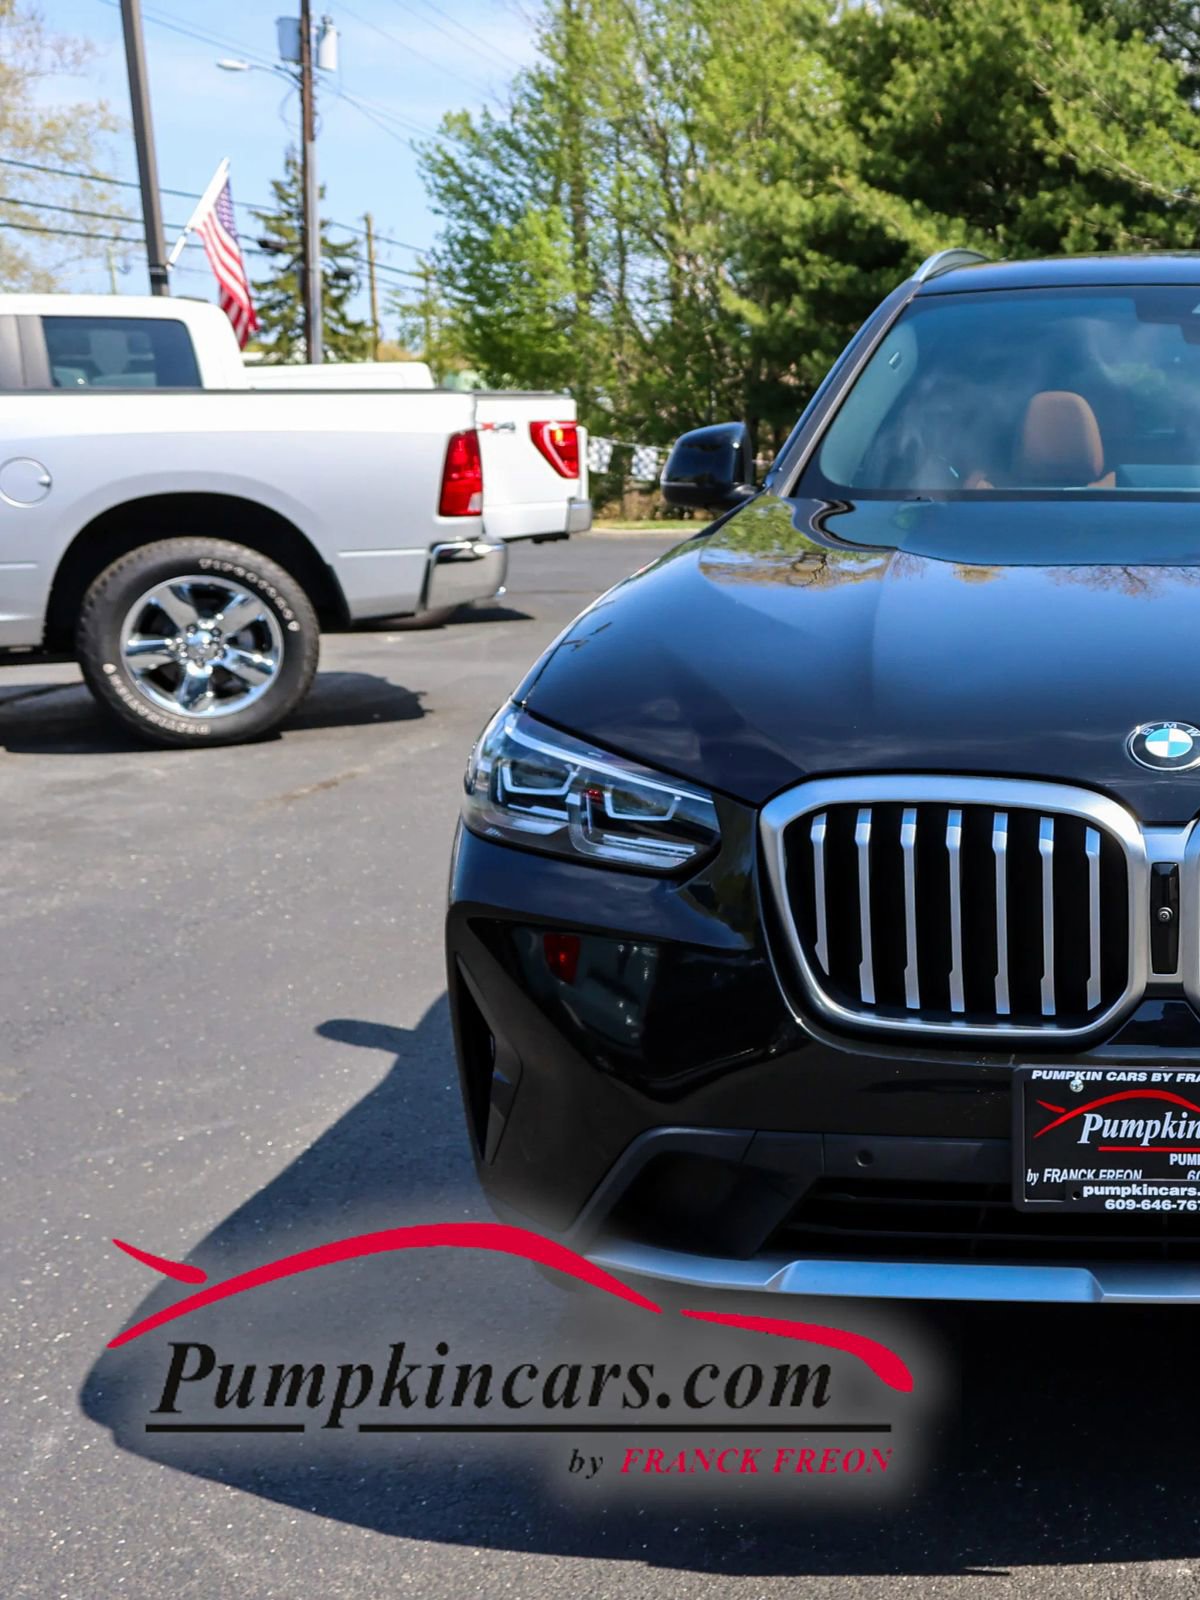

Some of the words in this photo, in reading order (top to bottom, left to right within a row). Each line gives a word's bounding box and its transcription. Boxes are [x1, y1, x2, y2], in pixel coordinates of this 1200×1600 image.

[1140, 722, 1200, 737] BMW
[1031, 1070, 1102, 1082] PUMPKIN
[1106, 1071, 1147, 1083] CARS
[1151, 1072, 1173, 1083] BY
[1026, 1168, 1040, 1186] by
[1043, 1168, 1096, 1183] FRANCK
